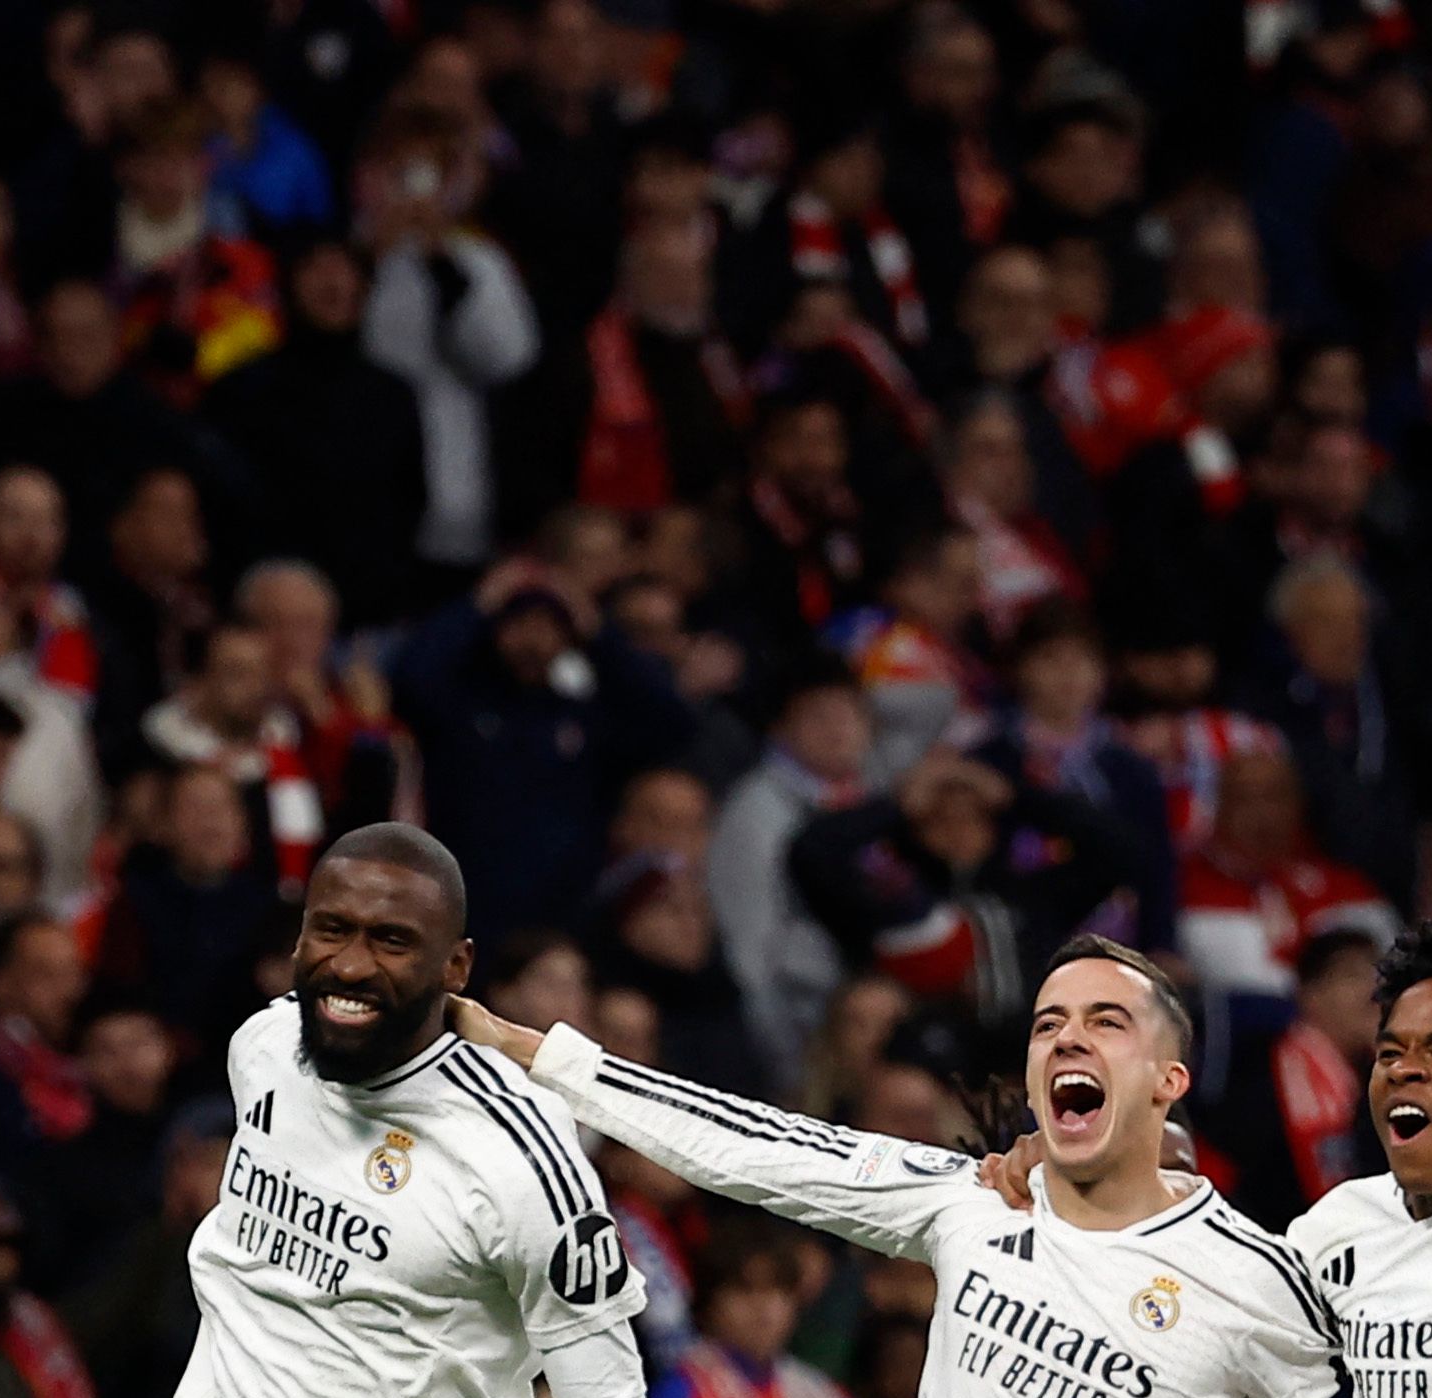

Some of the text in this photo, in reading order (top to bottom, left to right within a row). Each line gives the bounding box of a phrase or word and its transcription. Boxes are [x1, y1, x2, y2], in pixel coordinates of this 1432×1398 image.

[228, 1145, 391, 1262] Emirates
[237, 1211, 349, 1296] FLY BETTER
[555, 1215, 624, 1304] hp
[958, 1332, 1003, 1378] FLY
